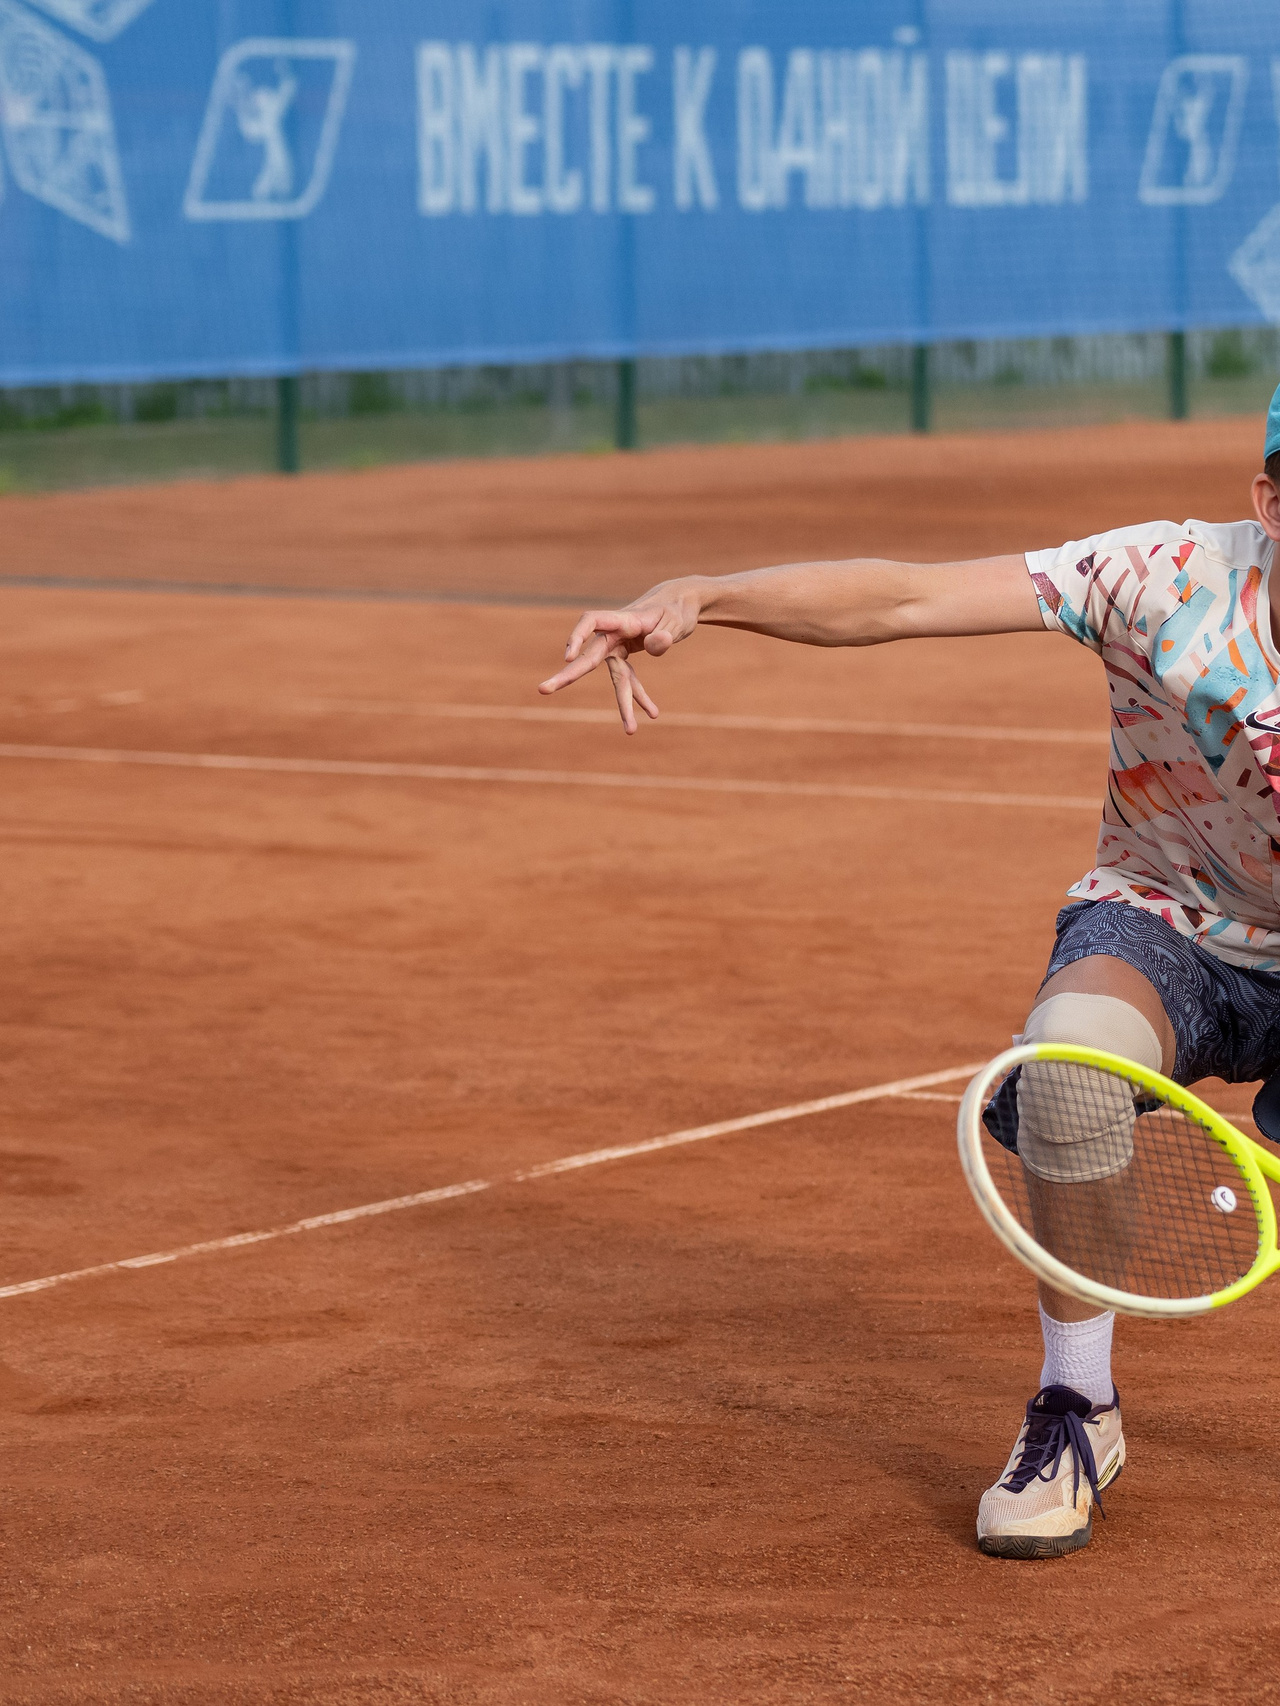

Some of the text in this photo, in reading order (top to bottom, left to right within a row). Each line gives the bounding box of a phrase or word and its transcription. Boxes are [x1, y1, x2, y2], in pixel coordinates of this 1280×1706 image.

[418, 41, 655, 215] ВМЕСТЕ
[673, 45, 718, 212] К
[736, 25, 930, 211] ОДНОЙ
